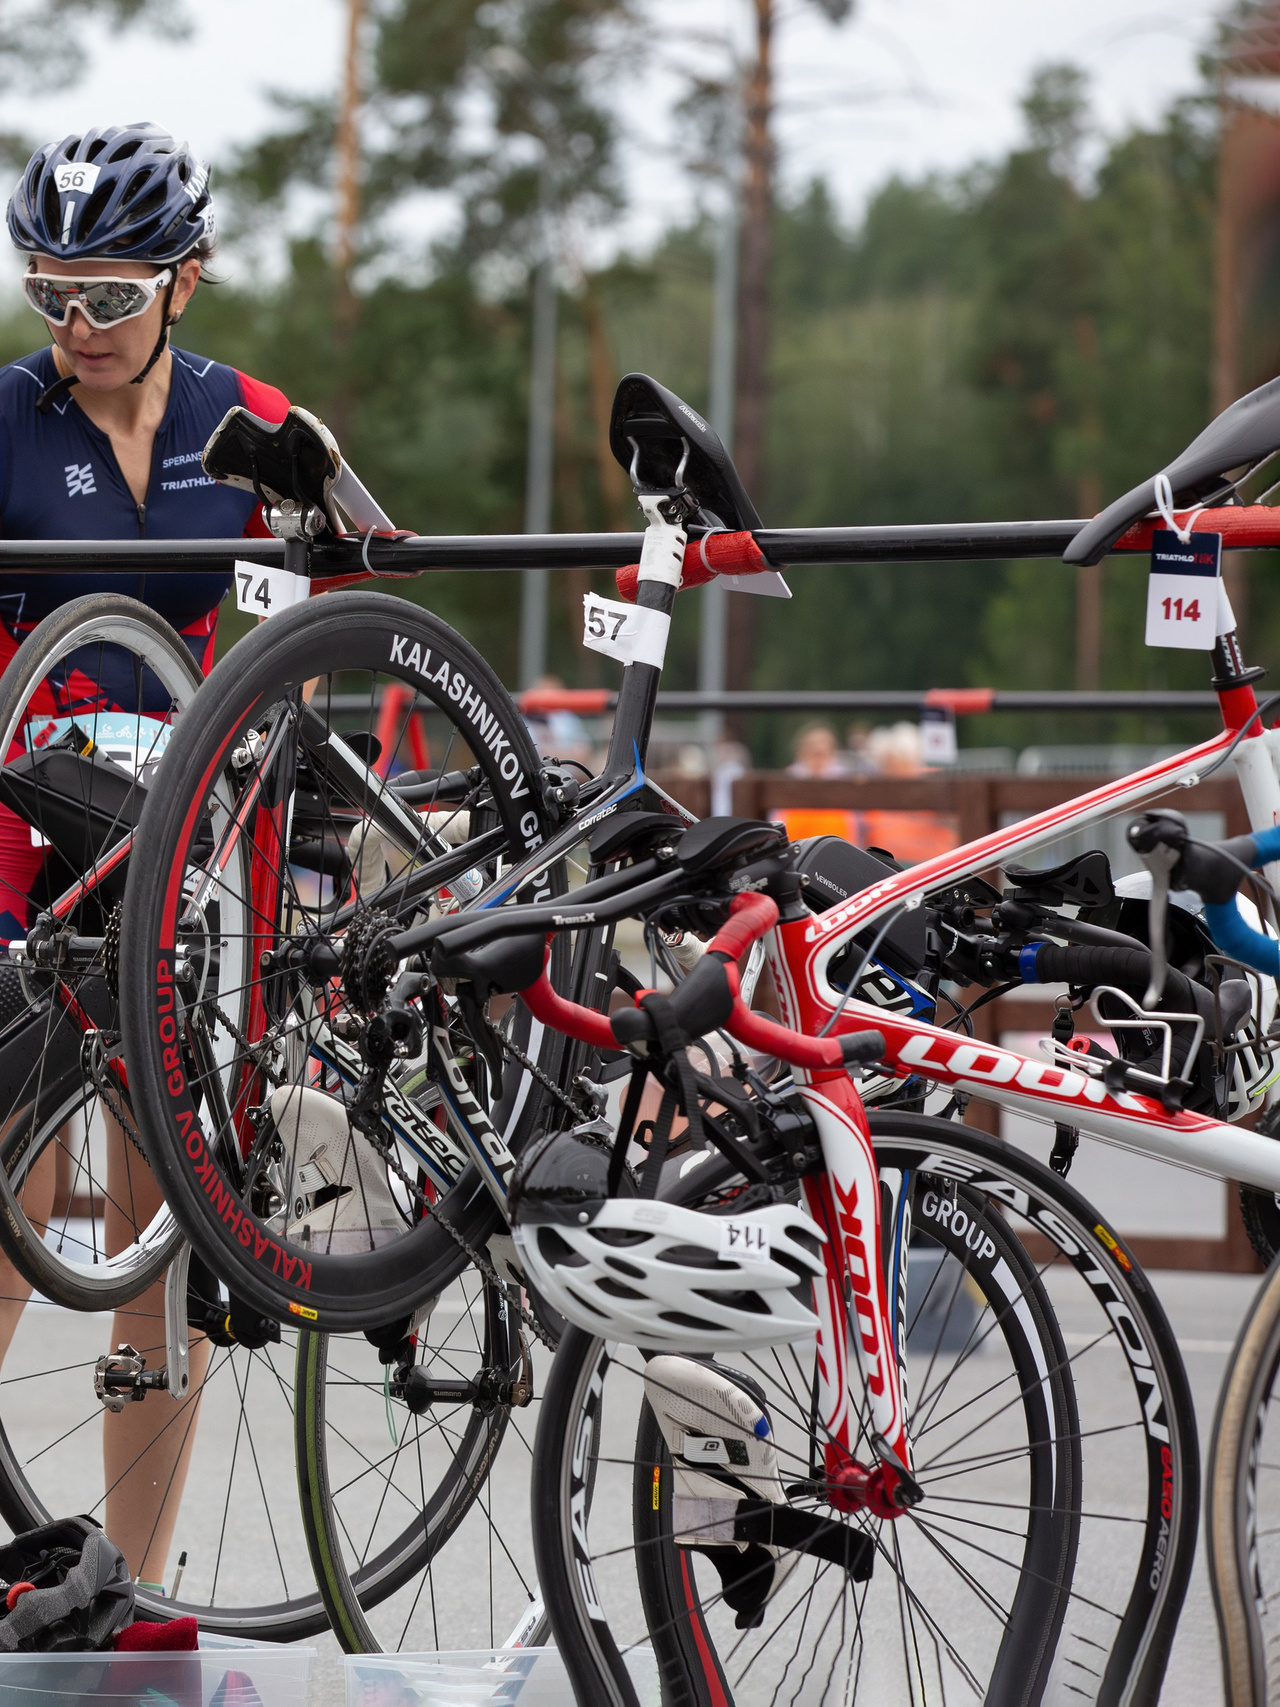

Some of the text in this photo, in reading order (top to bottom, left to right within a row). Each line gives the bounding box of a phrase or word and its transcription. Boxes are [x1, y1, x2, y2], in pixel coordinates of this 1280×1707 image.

[59, 171, 86, 188] 56
[162, 451, 203, 469] SPERANS
[161, 477, 218, 491] TRIATHLO
[237, 572, 272, 609] 74
[588, 606, 628, 641] 57
[1161, 597, 1201, 622] 114
[389, 634, 530, 800] KALASHNIKOV
[578, 803, 619, 831] corratec
[815, 871, 848, 899] NEWBOLER
[552, 912, 596, 925] TranzX
[805, 881, 899, 943] LOOK
[897, 1034, 1149, 1114] LOOK
[157, 959, 313, 1291] KALASHNIKOV GROUP
[727, 1223, 767, 1249] 114
[922, 1190, 997, 1260] GROUP
[831, 1169, 885, 1397] LOOK
[916, 1153, 1171, 1446] EASTON
[1148, 1515, 1170, 1592] AERO
